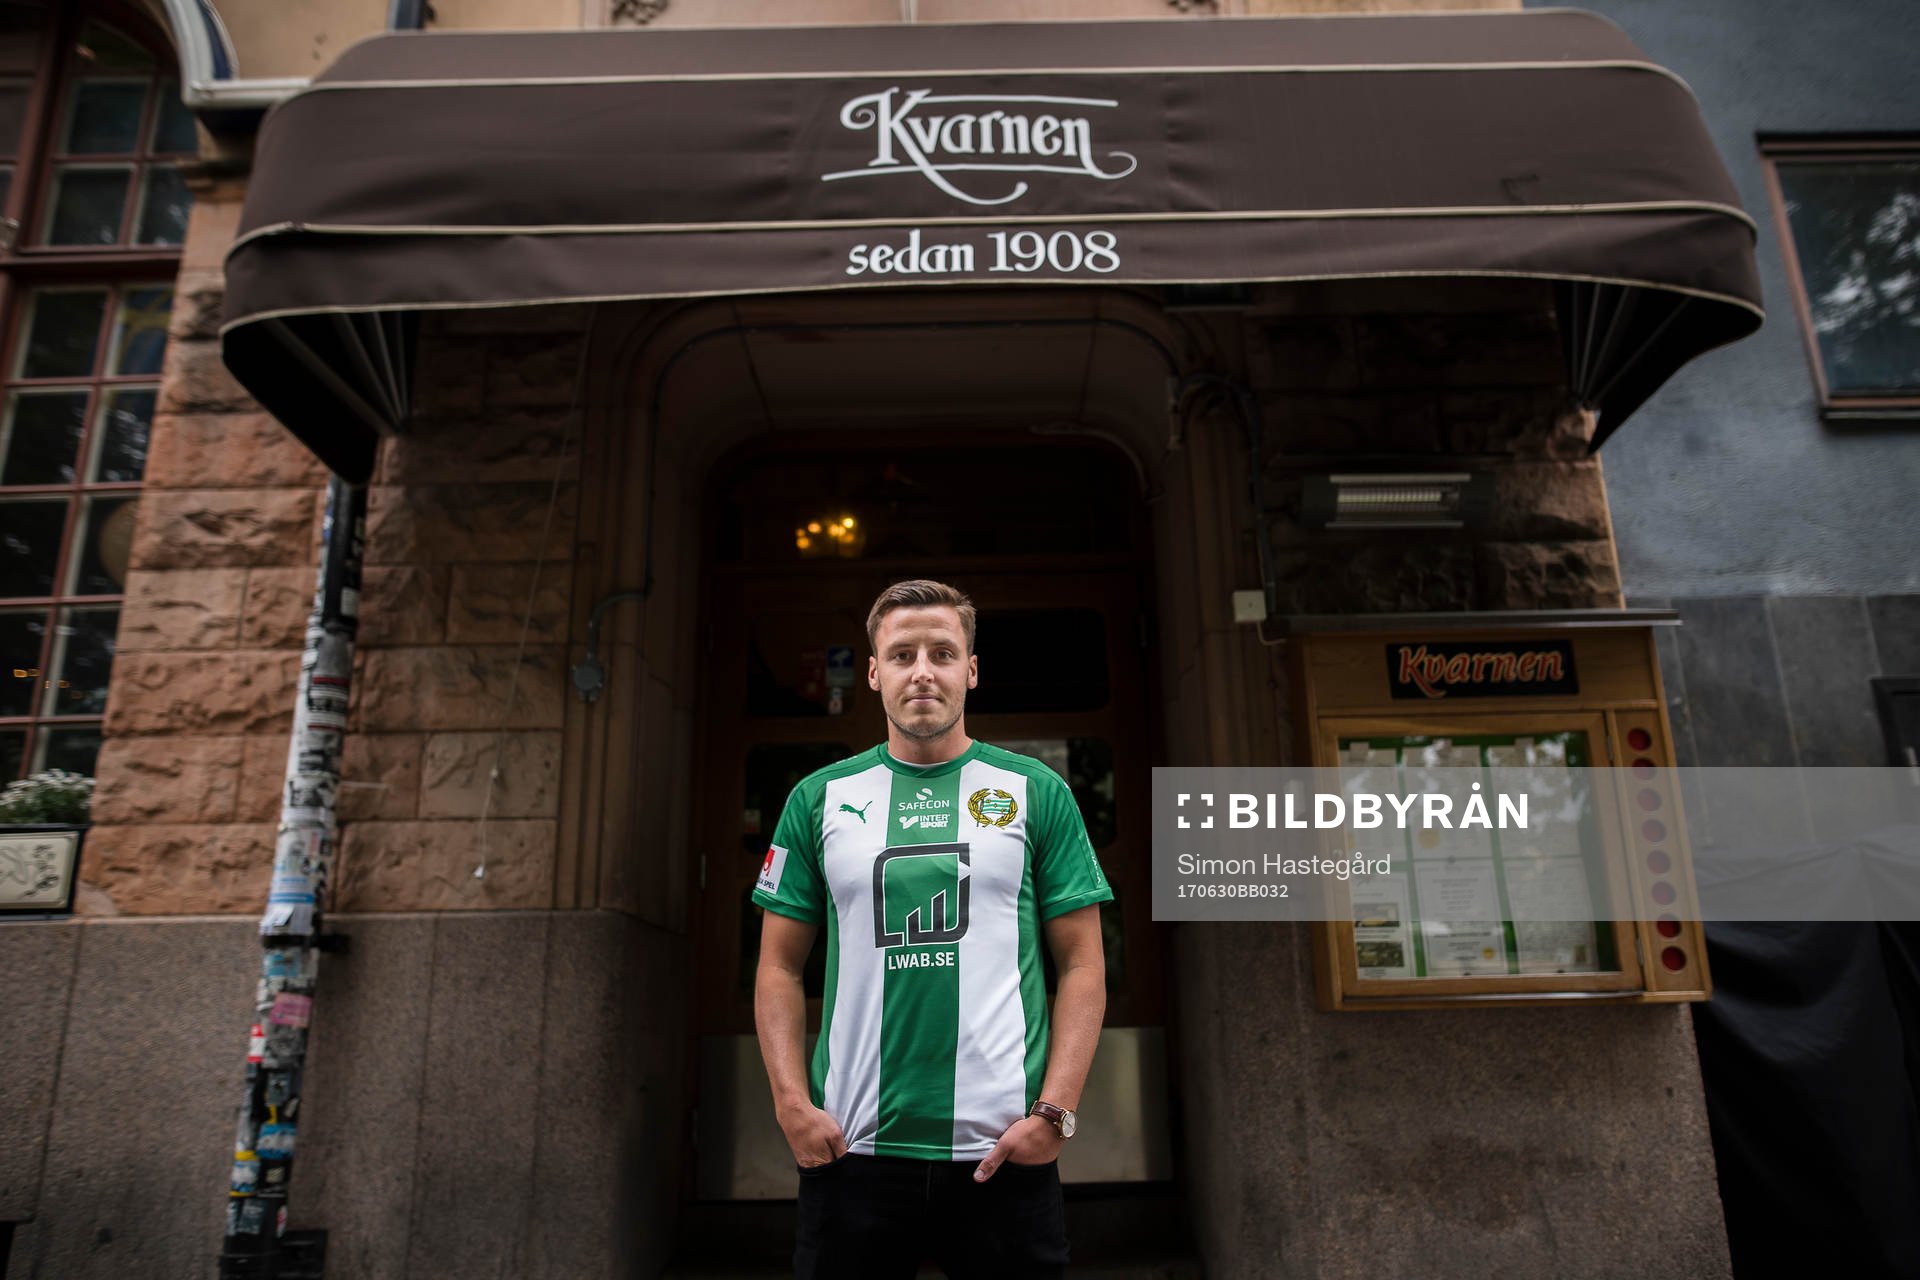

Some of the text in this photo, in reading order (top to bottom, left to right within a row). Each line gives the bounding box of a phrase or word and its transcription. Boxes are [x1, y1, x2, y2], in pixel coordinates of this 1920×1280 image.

[822, 87, 1137, 205] Kvarnen
[846, 229, 1121, 274] sedan 1908
[1398, 645, 1564, 698] Kvarnen
[898, 800, 949, 810] SAFECON
[920, 814, 949, 822] INTER
[888, 952, 954, 970] LWAB.SE
